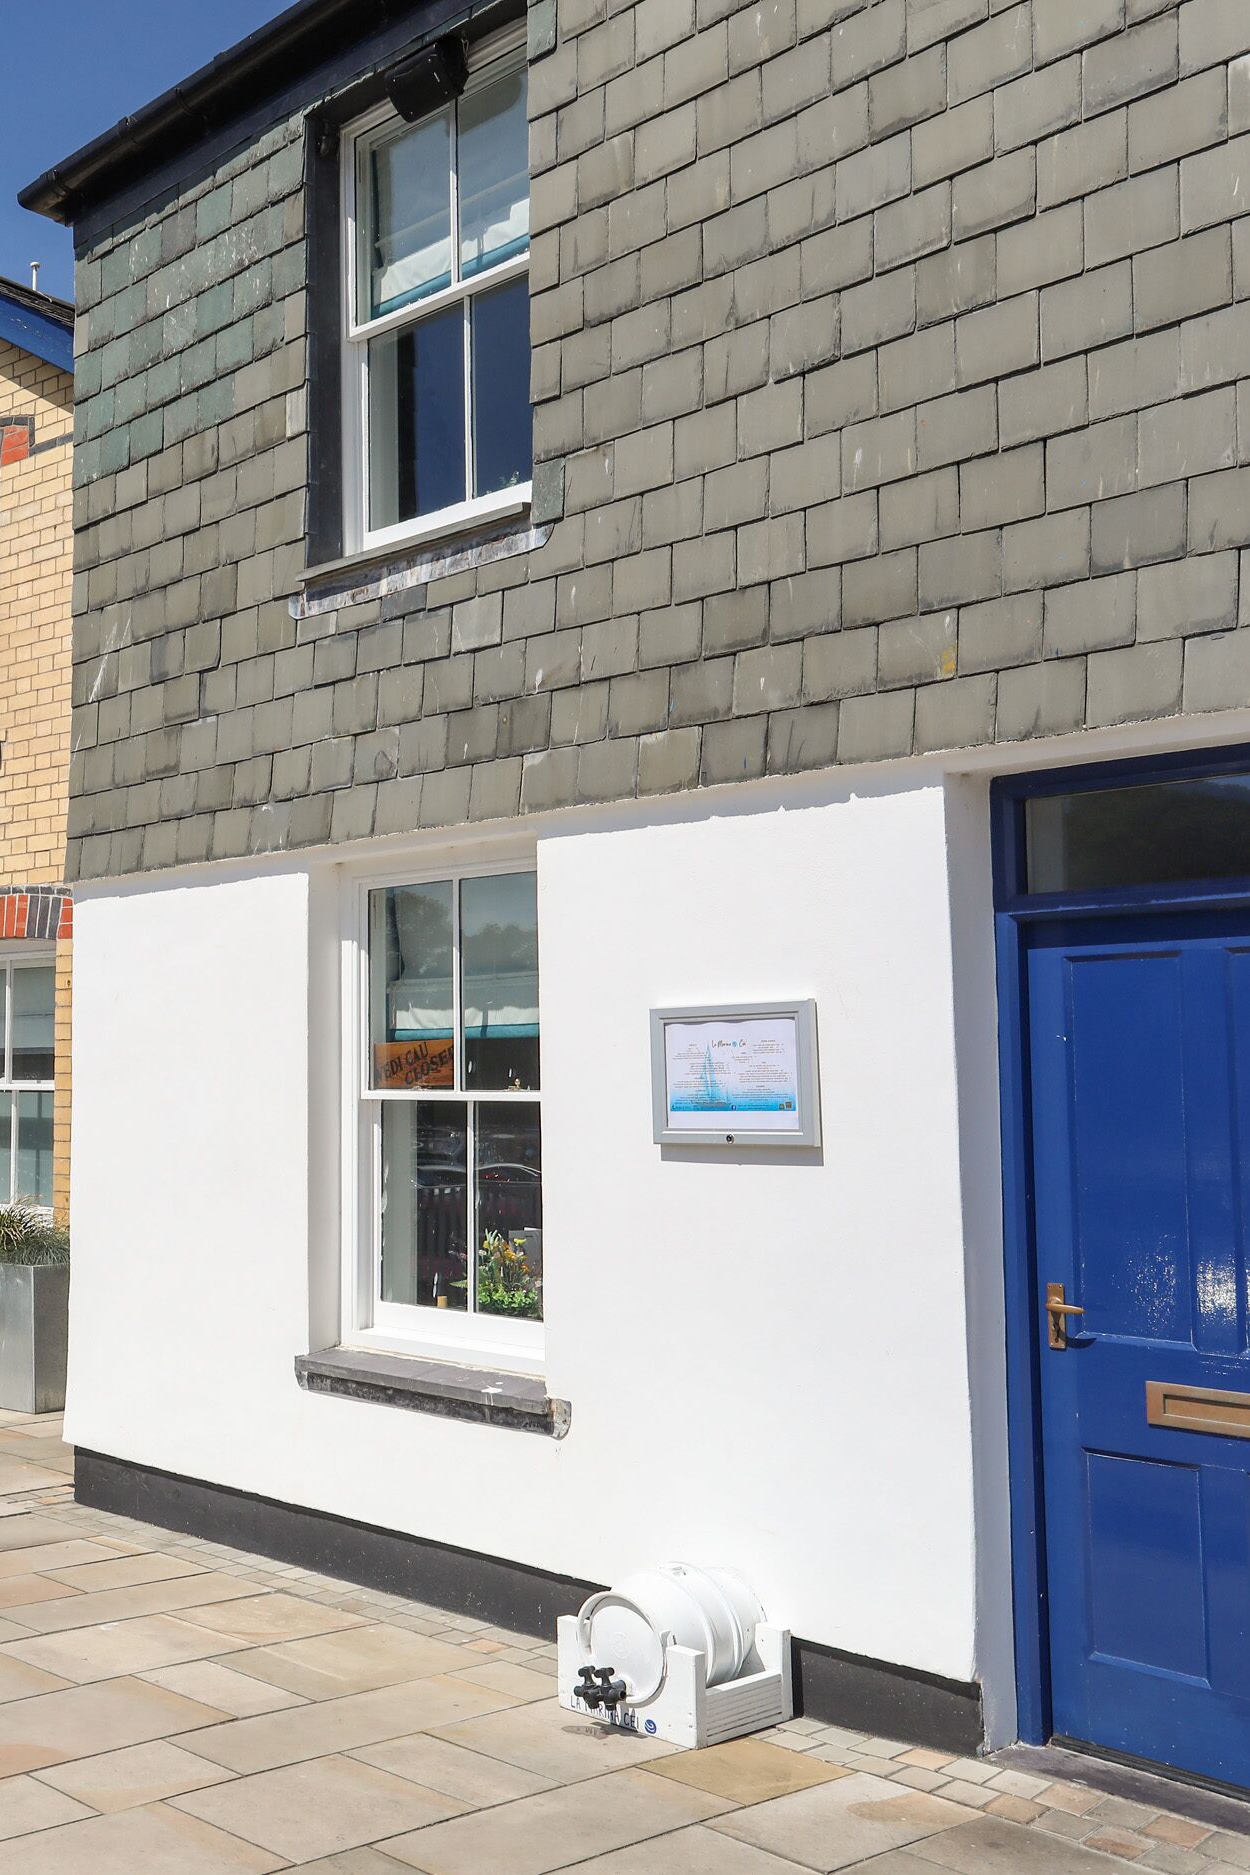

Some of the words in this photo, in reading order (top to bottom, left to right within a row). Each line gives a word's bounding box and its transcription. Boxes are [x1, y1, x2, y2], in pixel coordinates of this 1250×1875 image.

[406, 1041, 429, 1066] CAU
[571, 1695, 581, 1709] LA
[623, 1712, 639, 1729] CEI
